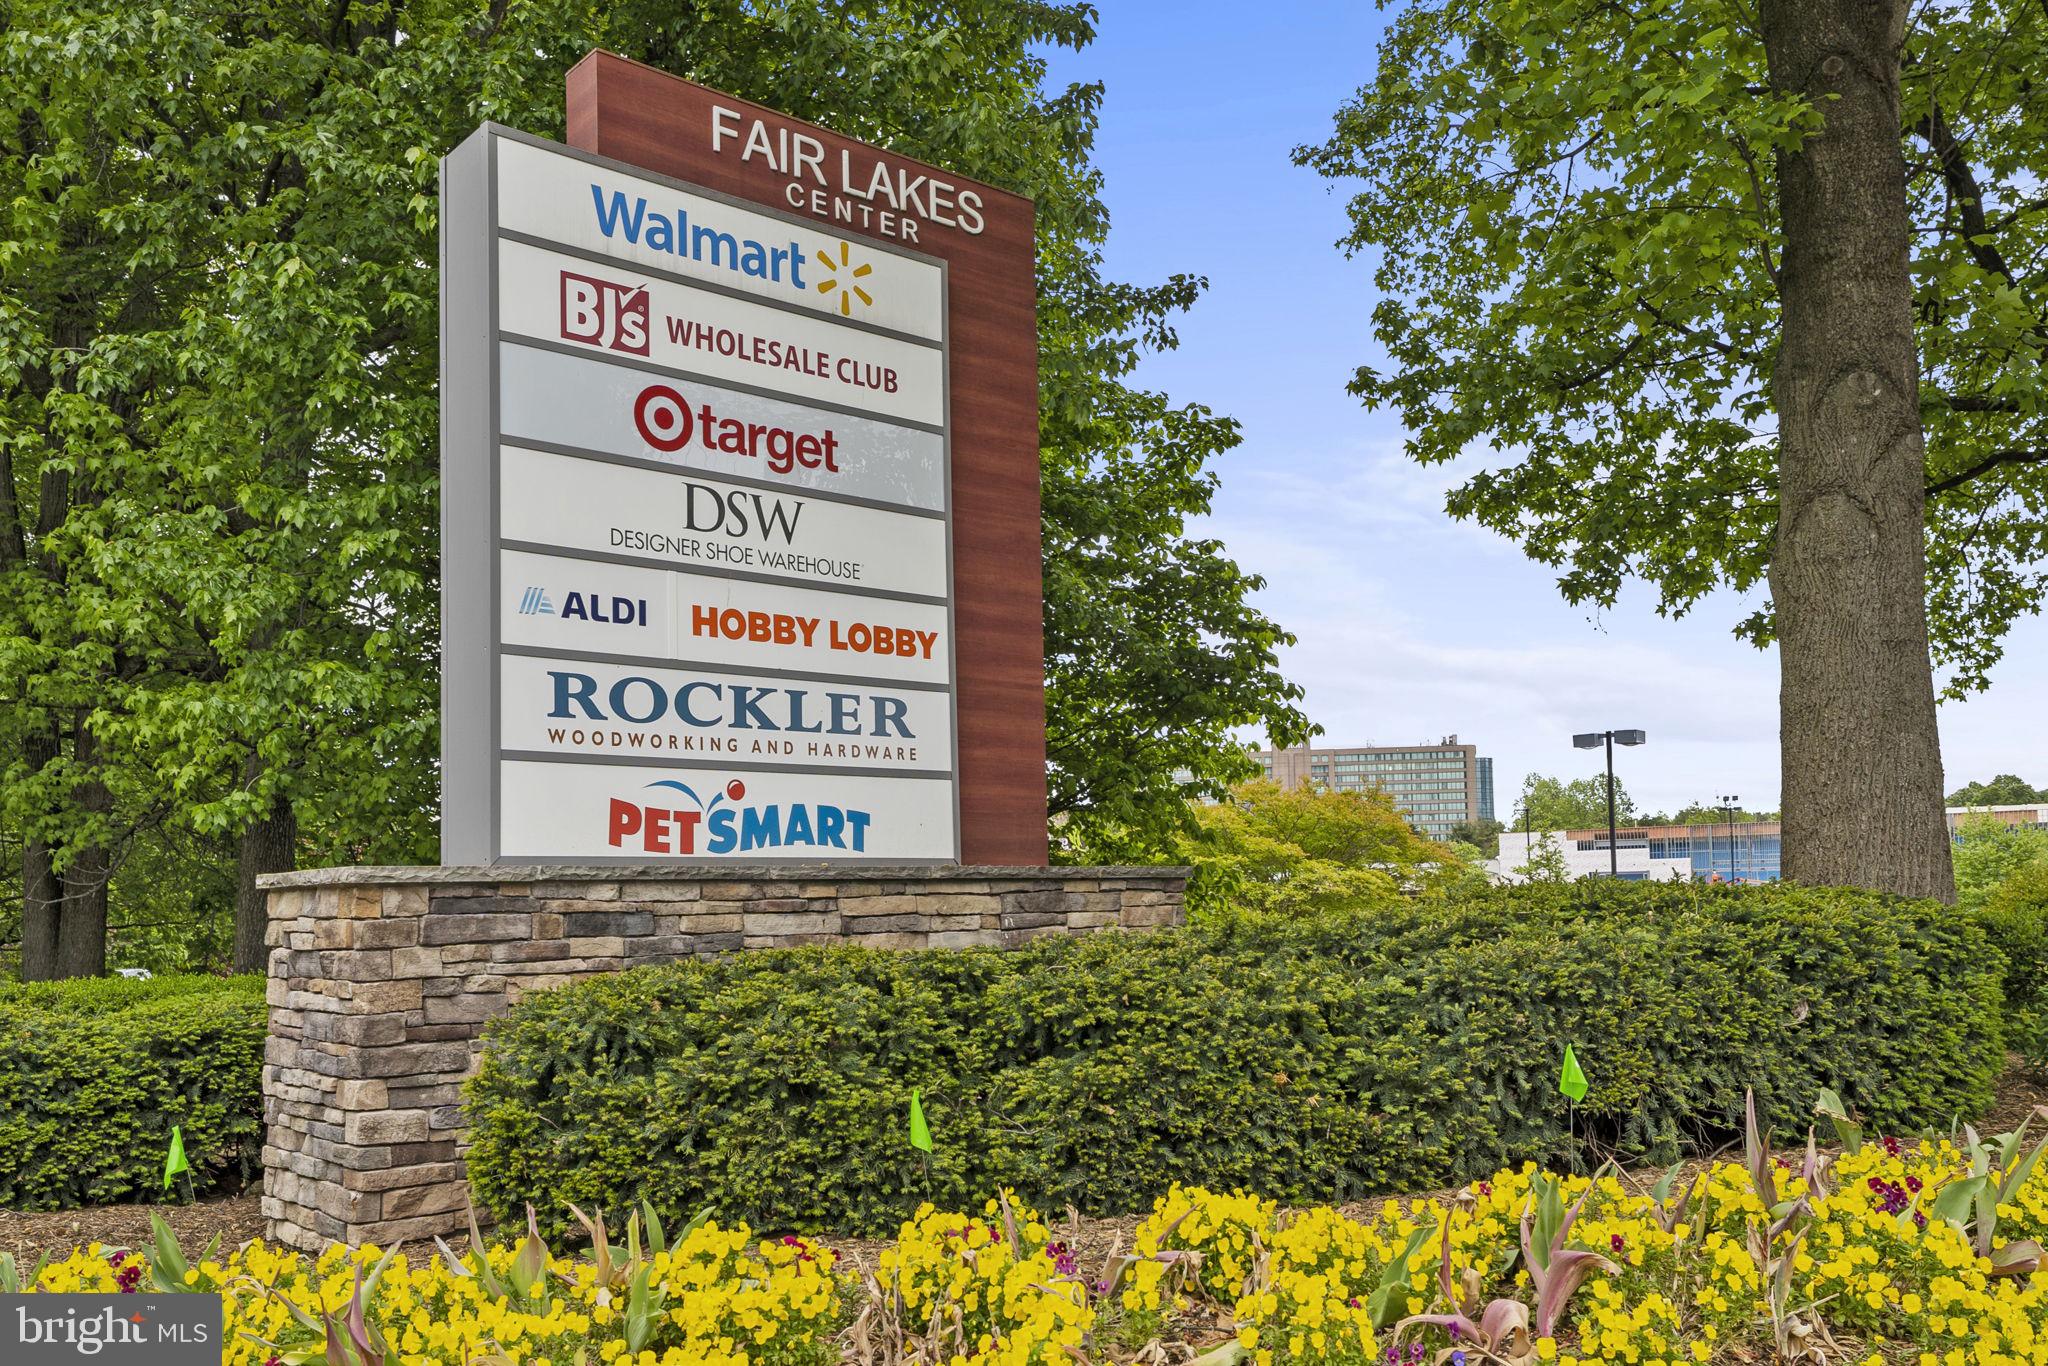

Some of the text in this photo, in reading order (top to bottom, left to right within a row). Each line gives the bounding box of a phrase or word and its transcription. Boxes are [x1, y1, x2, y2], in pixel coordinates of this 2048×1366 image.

[712, 105, 985, 235] FAIR LAKES
[590, 183, 806, 290] Walmart
[786, 182, 920, 244] CENTER
[666, 315, 830, 379] WHOLESALE
[836, 357, 899, 394] CLUB
[697, 404, 840, 475] target
[682, 481, 806, 546] DSW
[610, 527, 861, 580] DESIGNER SHOE WAREHOUSE
[561, 591, 647, 627] ALDI
[691, 604, 938, 660] HOBBY LOBBY
[546, 670, 916, 739] ROCKLER
[547, 728, 918, 762] WOODWORKING AND HARDWARE
[608, 797, 871, 855] PETSMART
